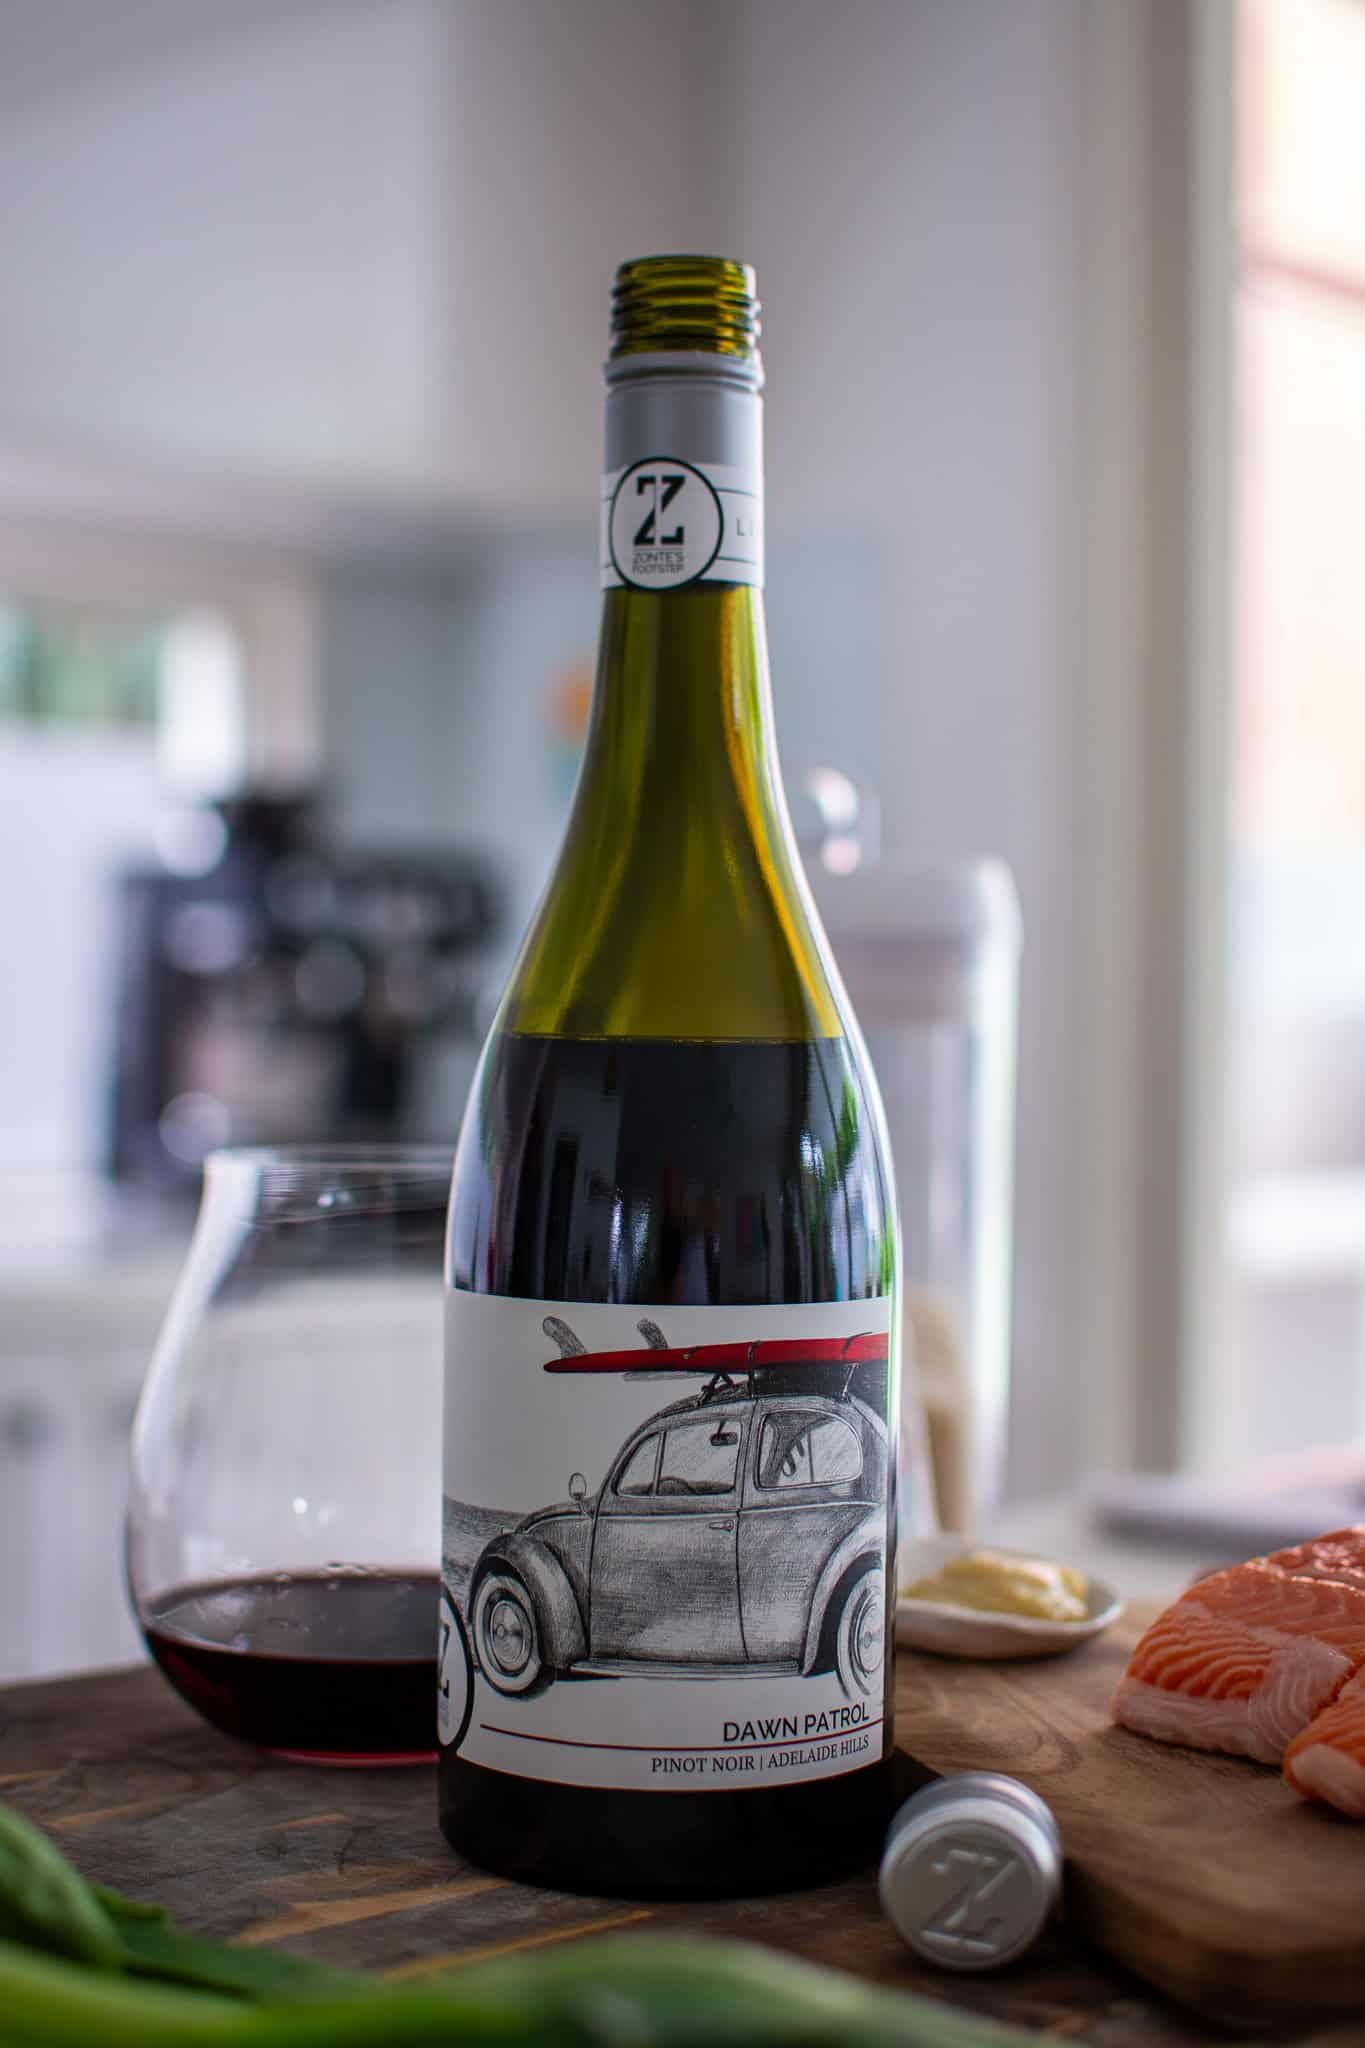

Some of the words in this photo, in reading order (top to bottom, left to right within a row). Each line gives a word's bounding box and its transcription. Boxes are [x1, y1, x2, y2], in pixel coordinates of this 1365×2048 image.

[723, 1716, 798, 1742] DAWN
[804, 1702, 870, 1734] PATROL
[651, 1757, 708, 1773] PINOT
[711, 1756, 755, 1773] NOIR
[767, 1744, 838, 1769] ADELAIDE
[840, 1734, 869, 1757] HILLS
